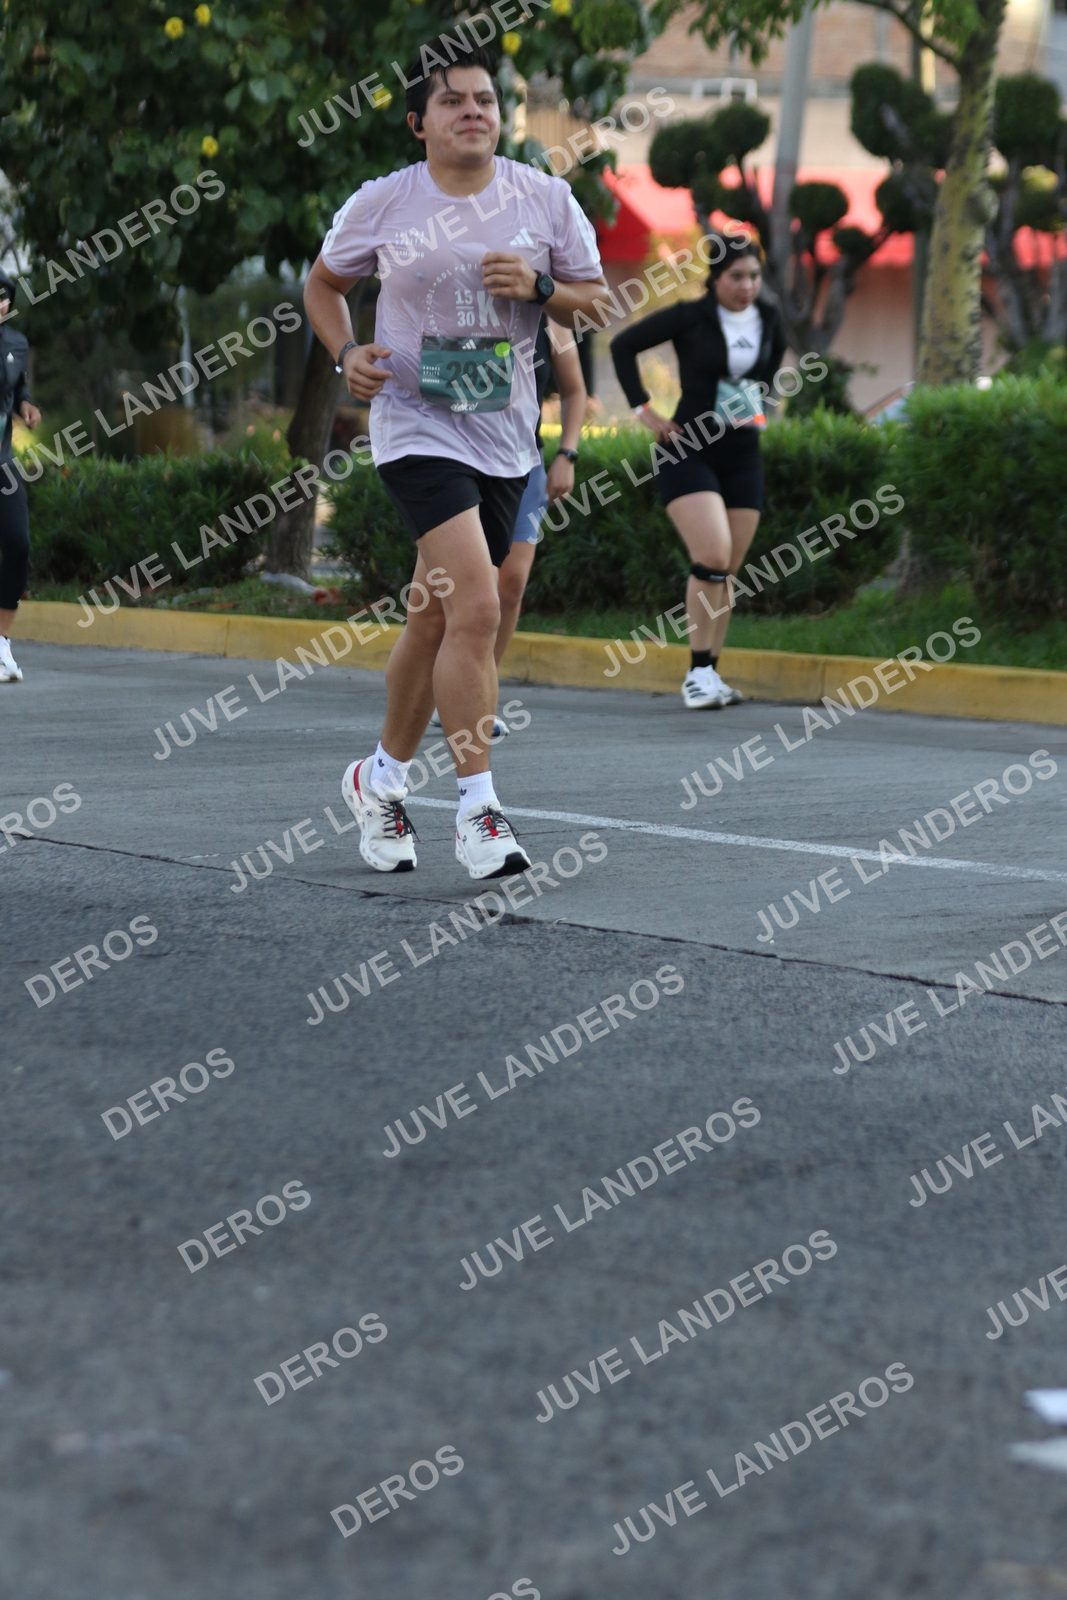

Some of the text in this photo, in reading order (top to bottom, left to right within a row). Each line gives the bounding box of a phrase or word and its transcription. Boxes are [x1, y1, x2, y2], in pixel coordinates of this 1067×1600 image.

[454, 289, 473, 305] 15
[476, 289, 500, 328] K
[457, 311, 475, 327] 30
